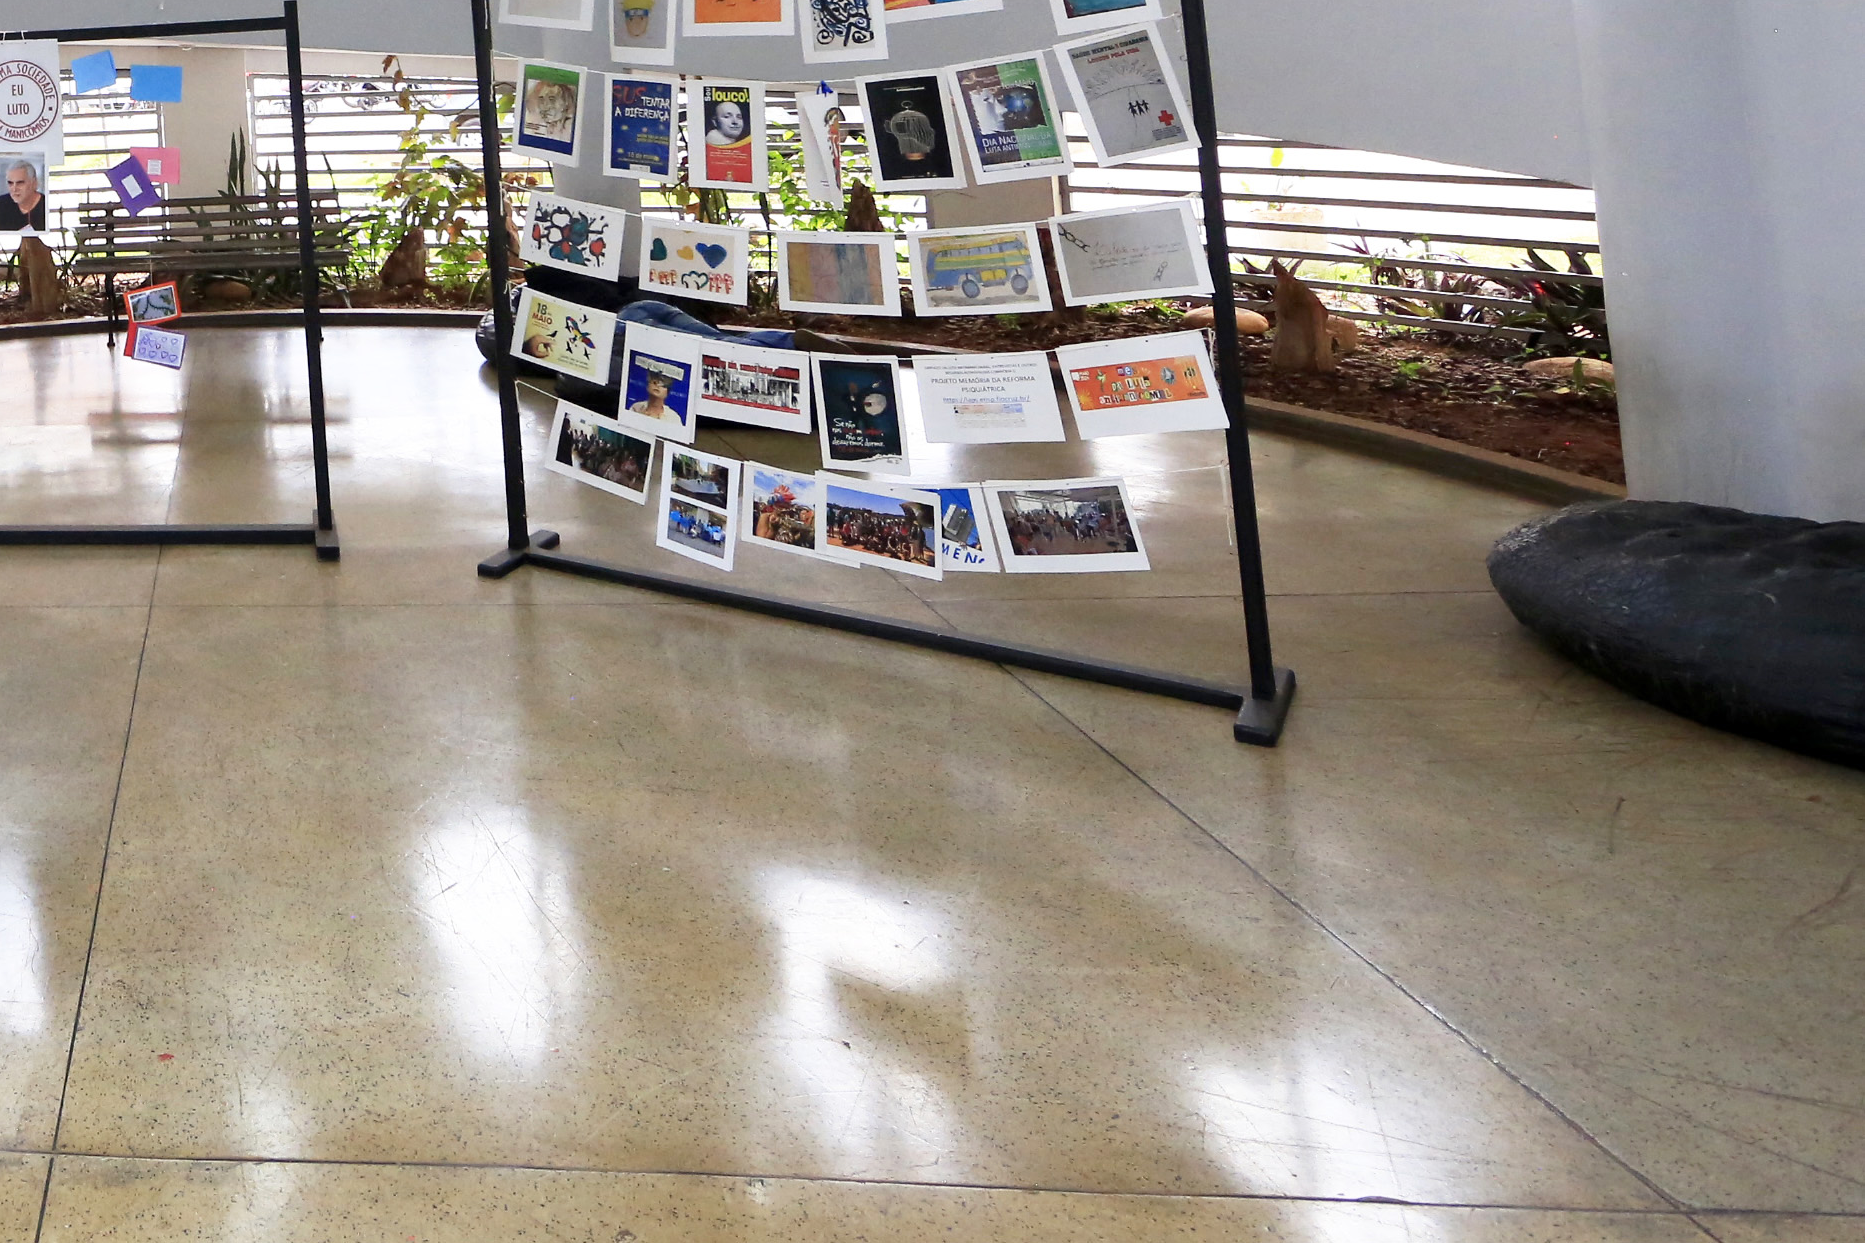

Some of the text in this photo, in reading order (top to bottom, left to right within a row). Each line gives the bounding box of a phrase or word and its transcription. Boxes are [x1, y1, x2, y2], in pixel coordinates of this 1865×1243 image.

[16, 63, 55, 99] SOCIEDADE
[11, 84, 24, 96] EU
[712, 88, 750, 103] louco!
[641, 96, 671, 109] TENTAR
[7, 103, 30, 115] LUTO
[614, 106, 670, 123] A DIFERENÇA
[984, 145, 1001, 154] LUTA
[537, 302, 547, 315] 18
[532, 313, 552, 325] MAIO
[958, 375, 990, 384] MEMÓRIA
[1002, 375, 1035, 383] REFORMA
[961, 385, 1006, 393] PSIQUIÁTRICA
